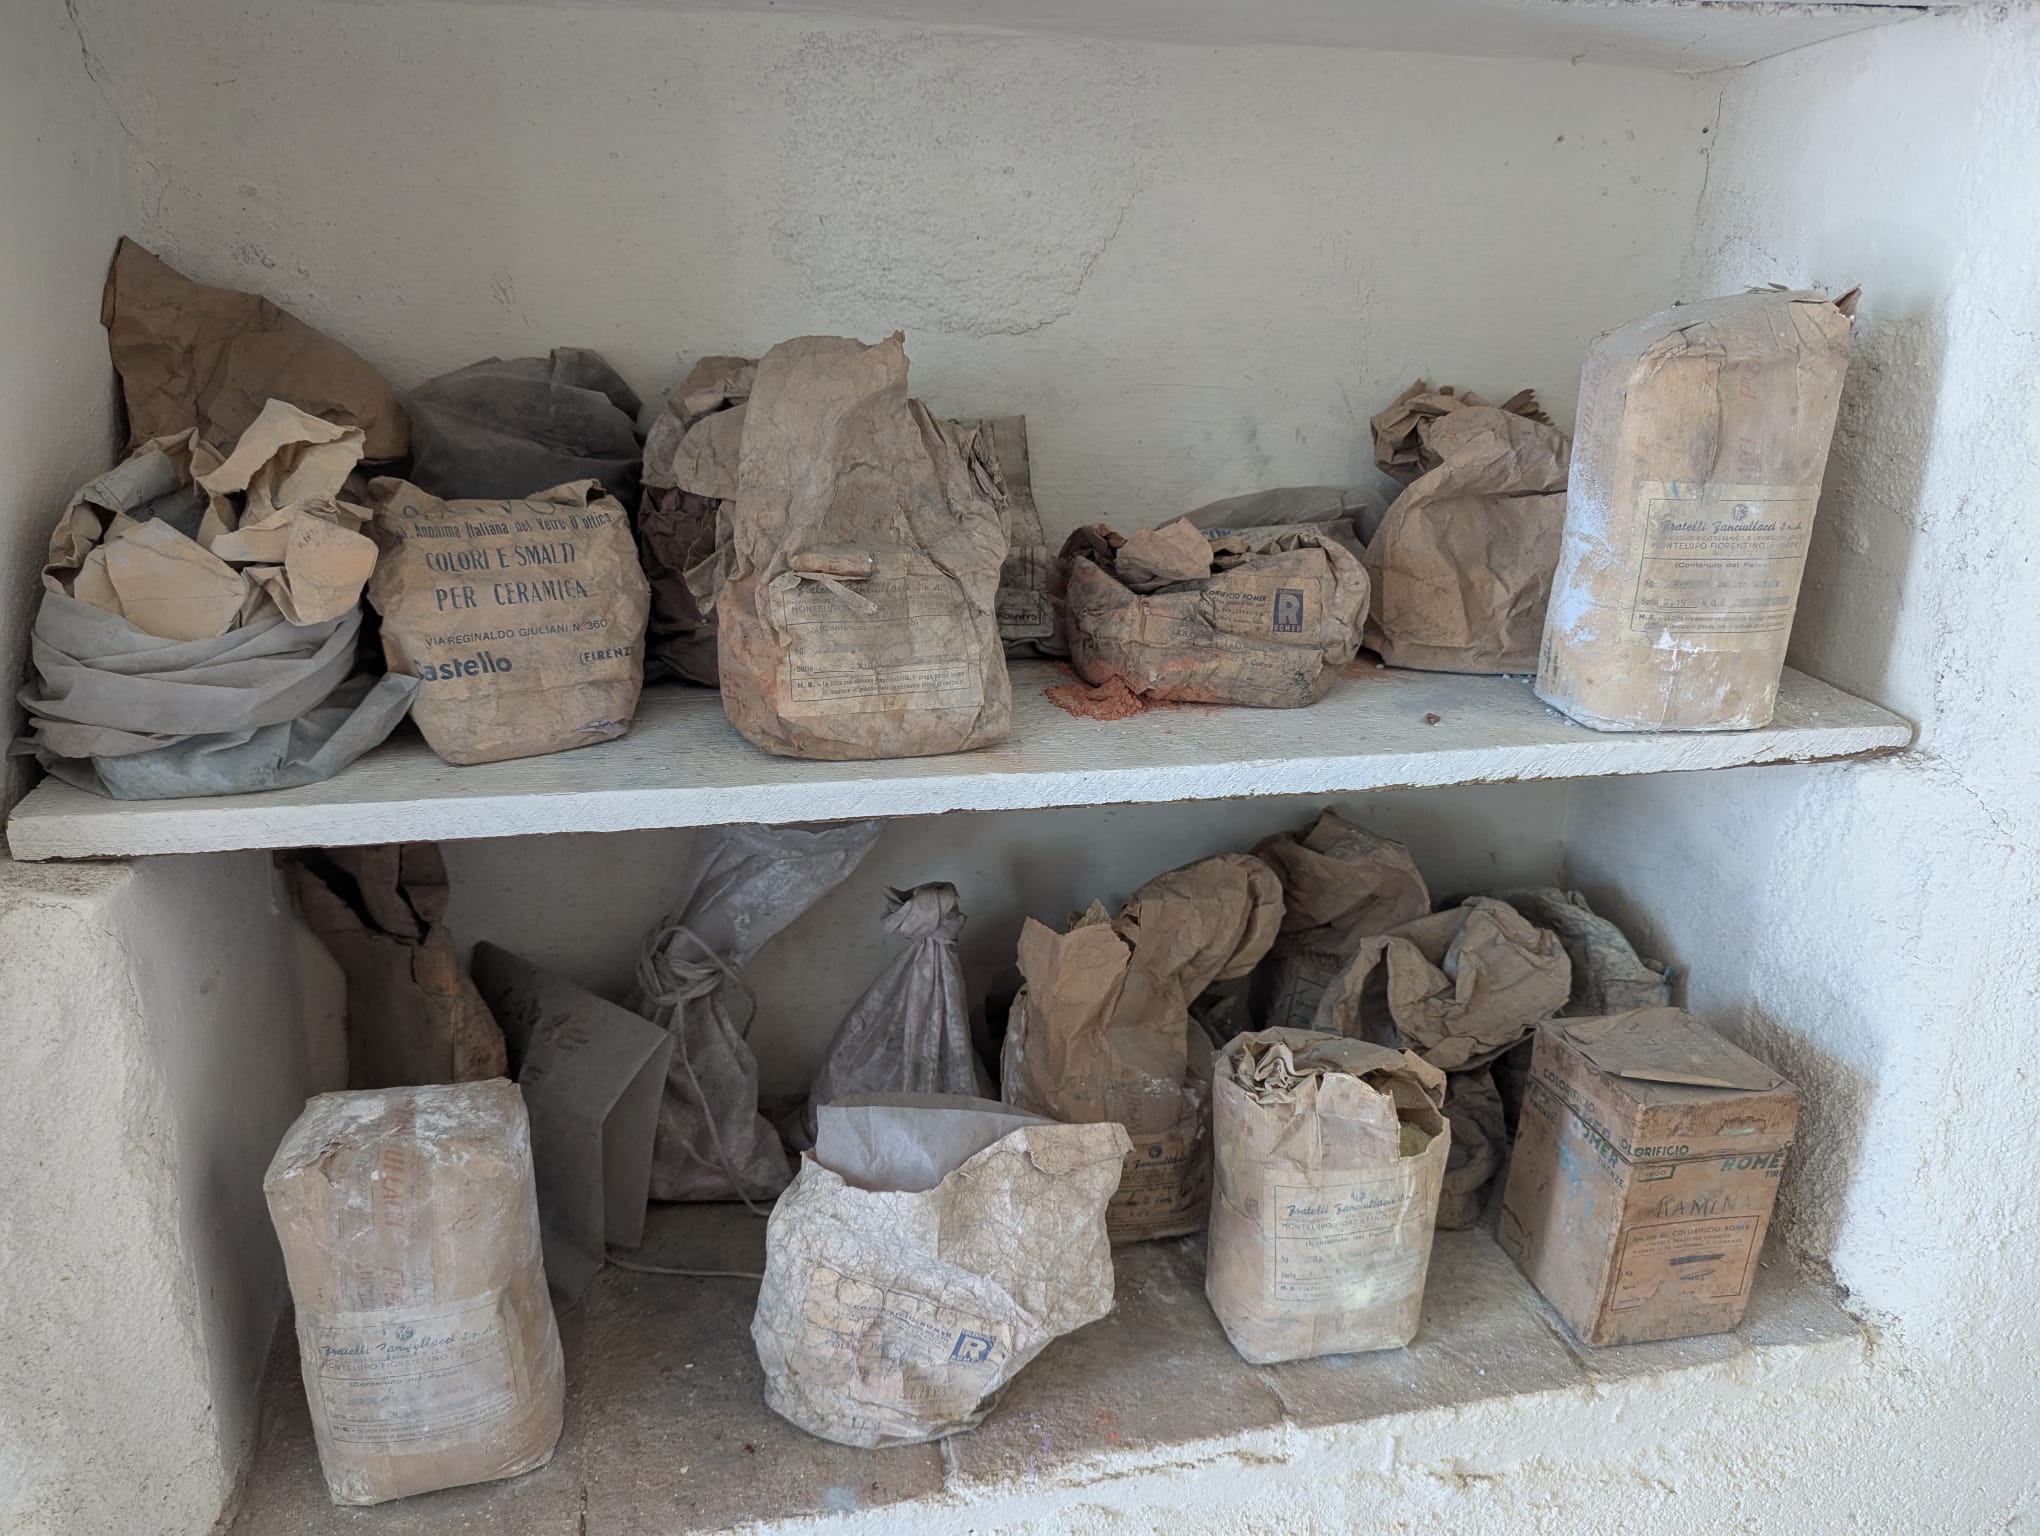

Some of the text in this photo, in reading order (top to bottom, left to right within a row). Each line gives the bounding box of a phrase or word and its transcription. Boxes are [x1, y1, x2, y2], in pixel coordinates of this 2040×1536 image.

[414, 522, 461, 539] Anonima
[466, 520, 509, 538] Italiana
[425, 543, 576, 573] COLORI E SMALTI
[435, 578, 588, 612] PER CERAMICA
[424, 619, 608, 649] VIA REGINALDO GIULIANI N. 360
